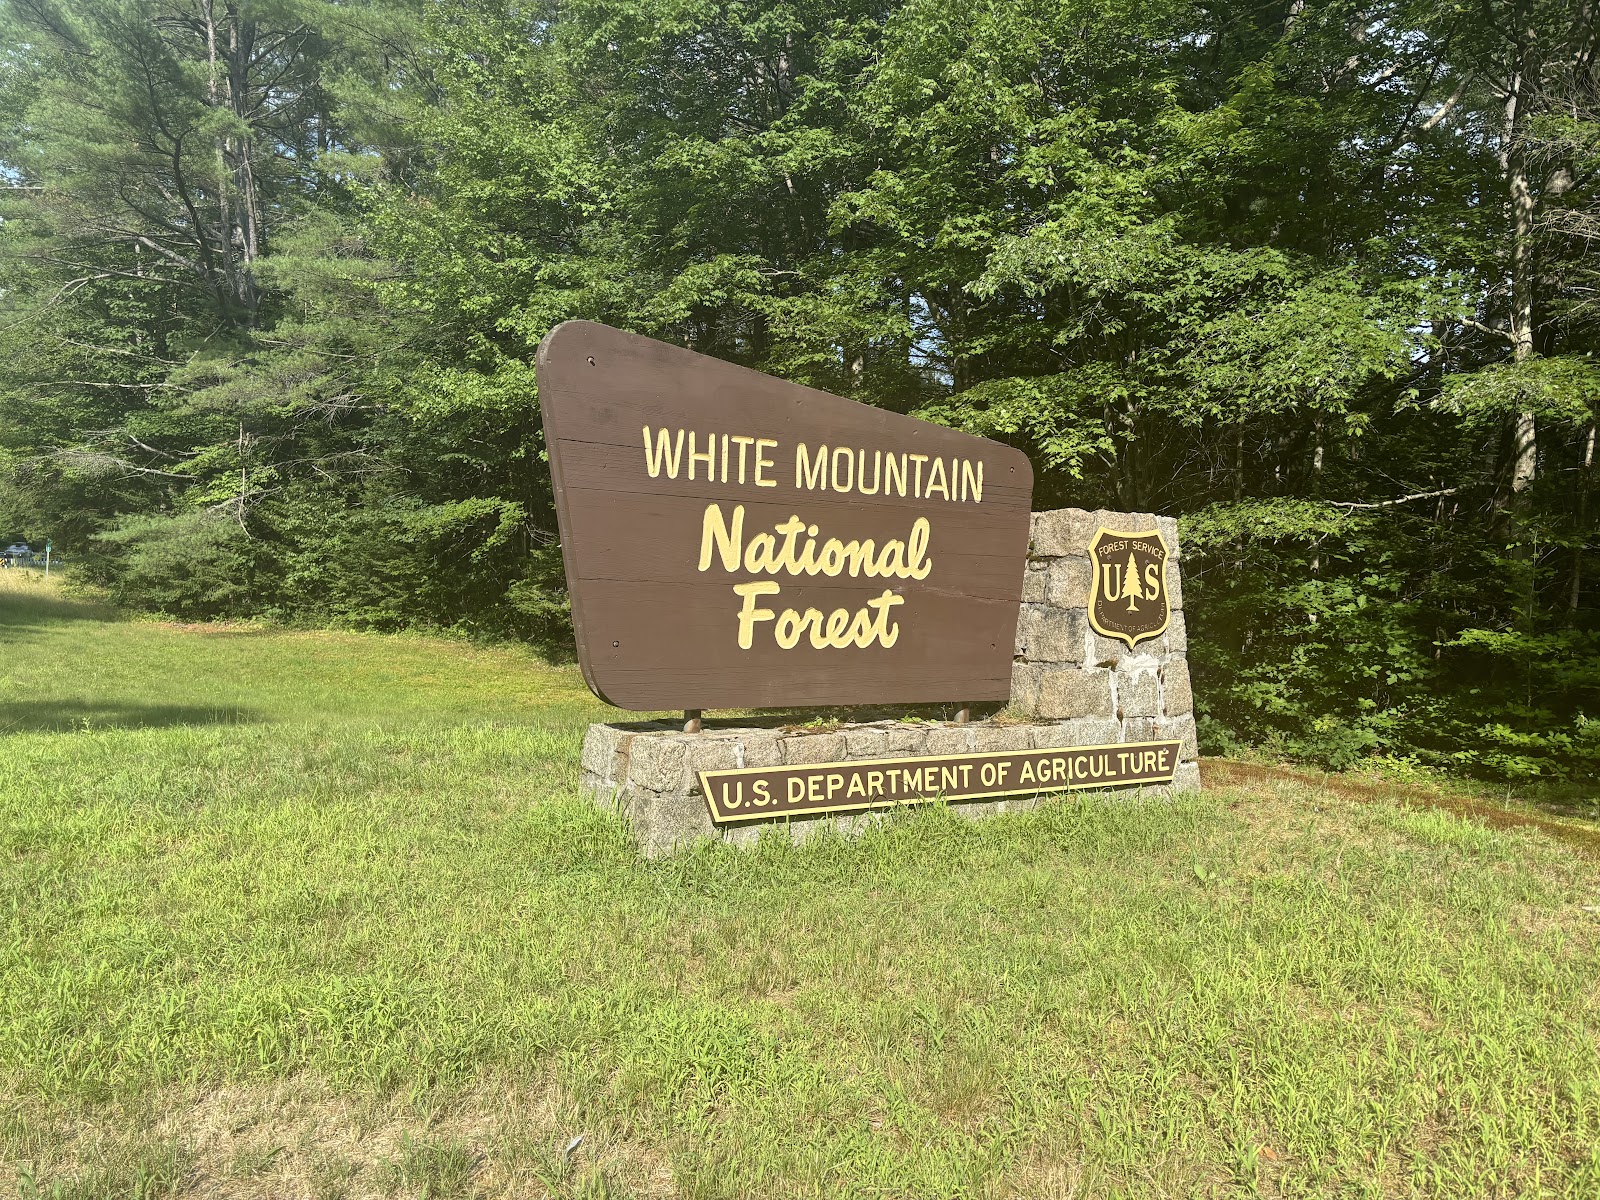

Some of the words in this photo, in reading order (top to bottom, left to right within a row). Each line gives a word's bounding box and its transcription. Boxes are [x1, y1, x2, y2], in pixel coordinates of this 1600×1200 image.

[642, 425, 778, 487] WHITE
[795, 442, 984, 503] MOUNTAIN
[697, 503, 932, 580] National
[1098, 540, 1129, 557] FOREST
[1132, 540, 1164, 560] SERVICE
[732, 580, 905, 650] Forest
[1128, 625, 1136, 633] OF
[722, 779, 778, 809] U.S.
[787, 763, 973, 803] DEPARTMENT
[980, 761, 1012, 787] OF
[1019, 750, 1170, 784] AGRICULTURE
